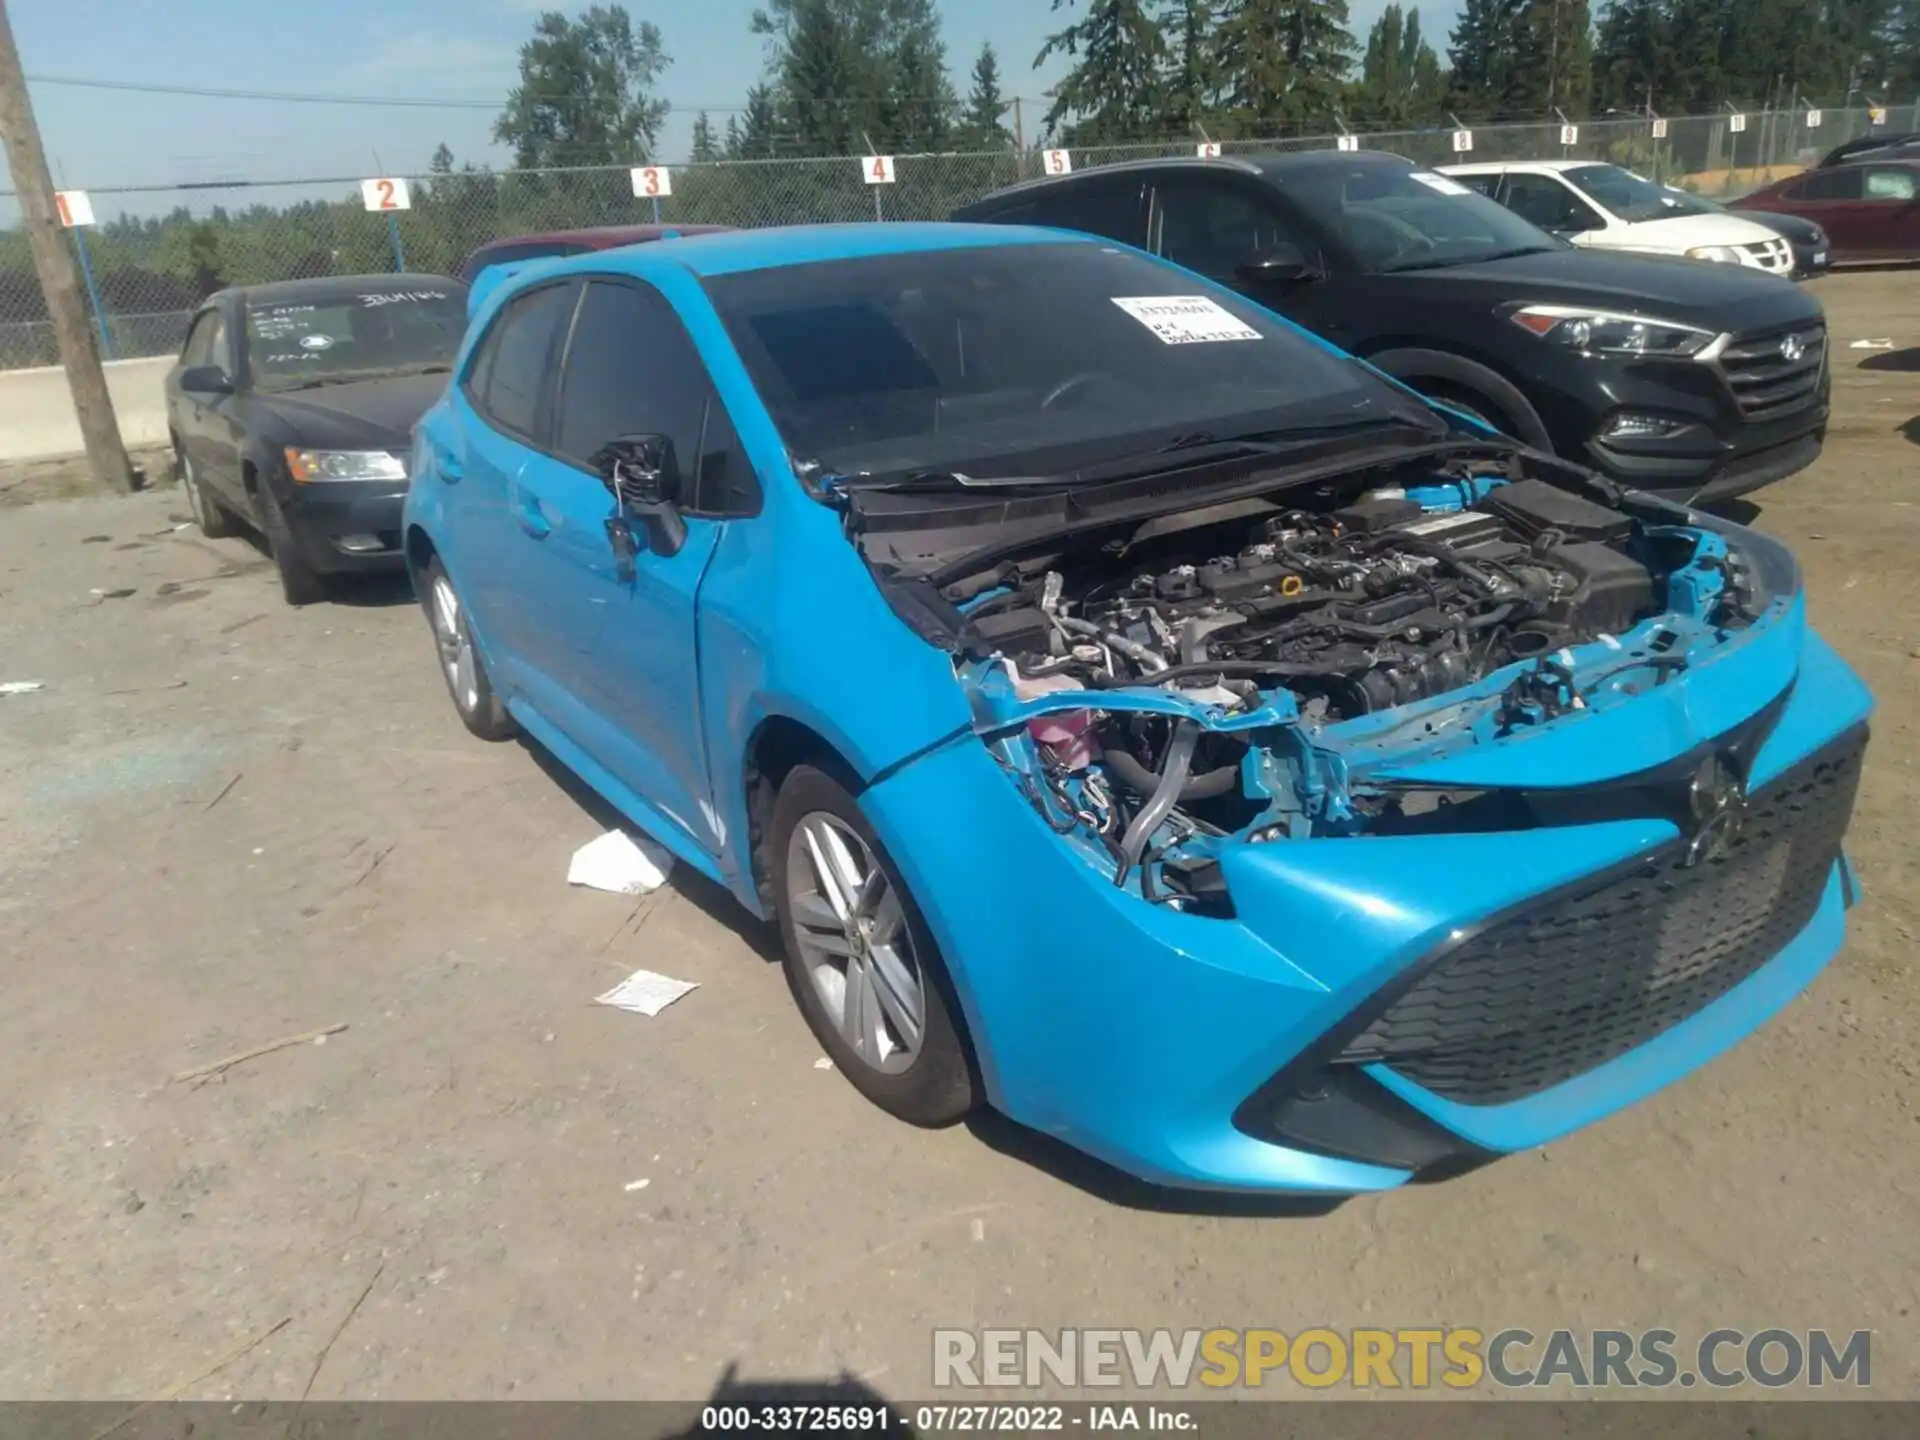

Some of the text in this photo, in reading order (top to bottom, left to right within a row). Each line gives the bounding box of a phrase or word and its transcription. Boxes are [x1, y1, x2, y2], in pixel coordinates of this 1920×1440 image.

[1459, 132, 1466, 149] 8
[1566, 126, 1573, 143] 9
[873, 157, 886, 182] 4
[1051, 151, 1063, 173] 5
[644, 167, 659, 195] 3
[376, 180, 397, 208] 2
[54, 194, 73, 226] 1
